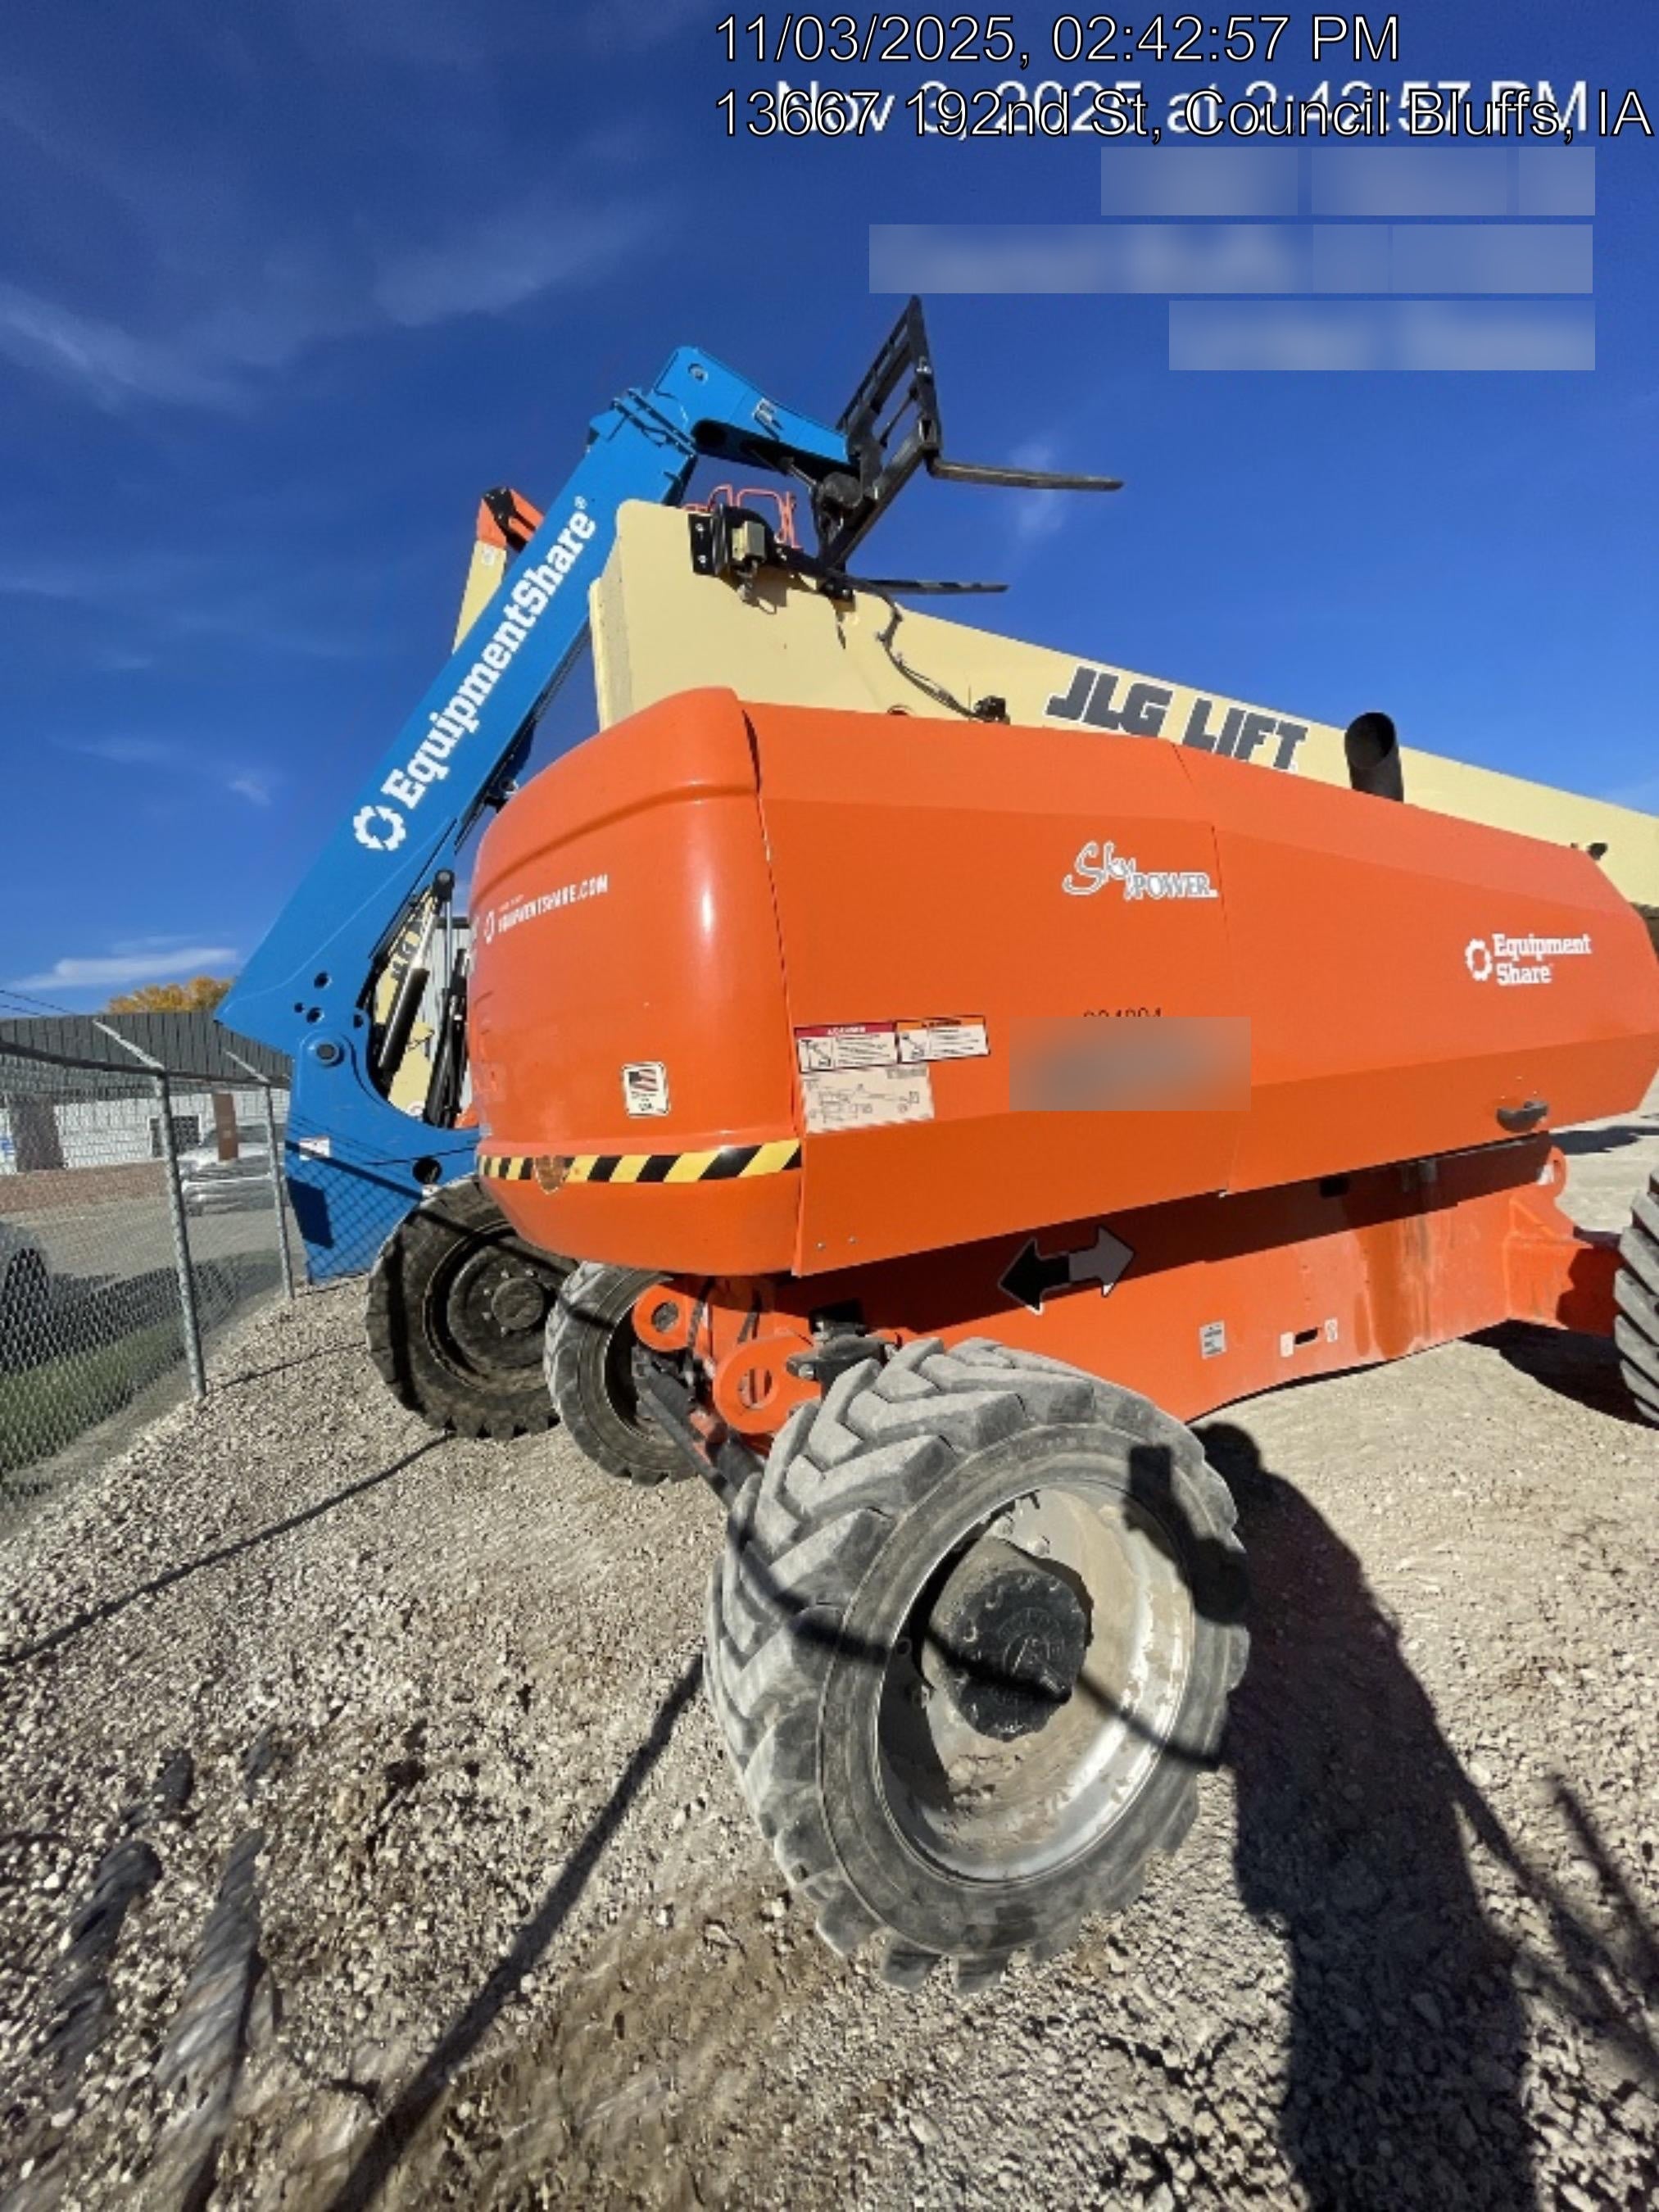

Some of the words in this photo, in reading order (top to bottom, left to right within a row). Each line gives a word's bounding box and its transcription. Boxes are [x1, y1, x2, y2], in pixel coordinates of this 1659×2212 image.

[1044, 664, 1174, 737] JLG
[1181, 696, 1309, 770] LIFT
[1491, 932, 1593, 962] Equipment
[1496, 962, 1553, 986] Share
